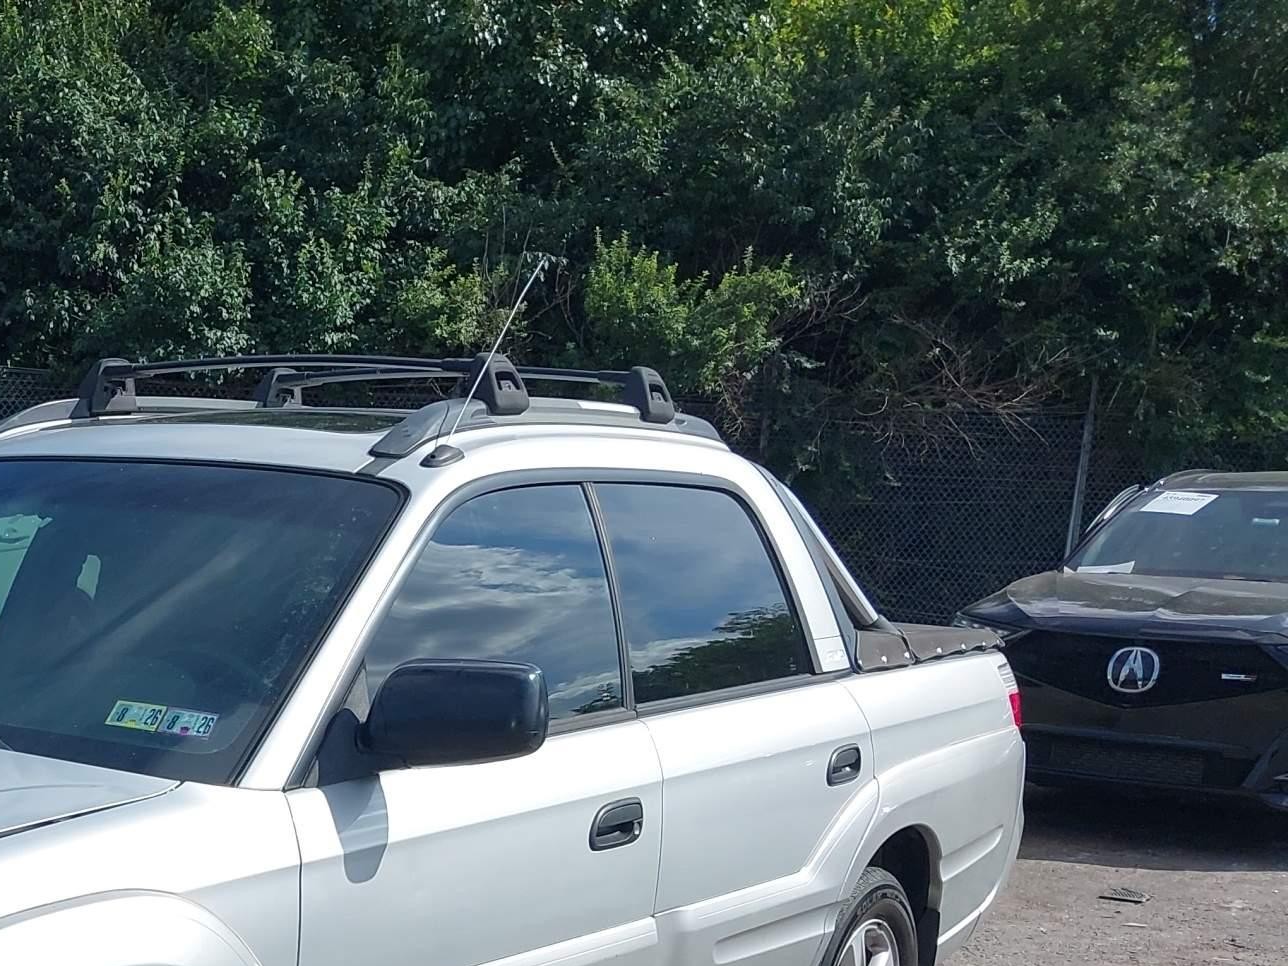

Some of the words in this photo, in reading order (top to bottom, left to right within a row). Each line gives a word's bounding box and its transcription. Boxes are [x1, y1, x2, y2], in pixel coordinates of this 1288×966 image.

[117, 707, 129, 722] 8
[143, 708, 163, 726] 26
[166, 714, 180, 730] 8
[196, 716, 215, 734] 26
